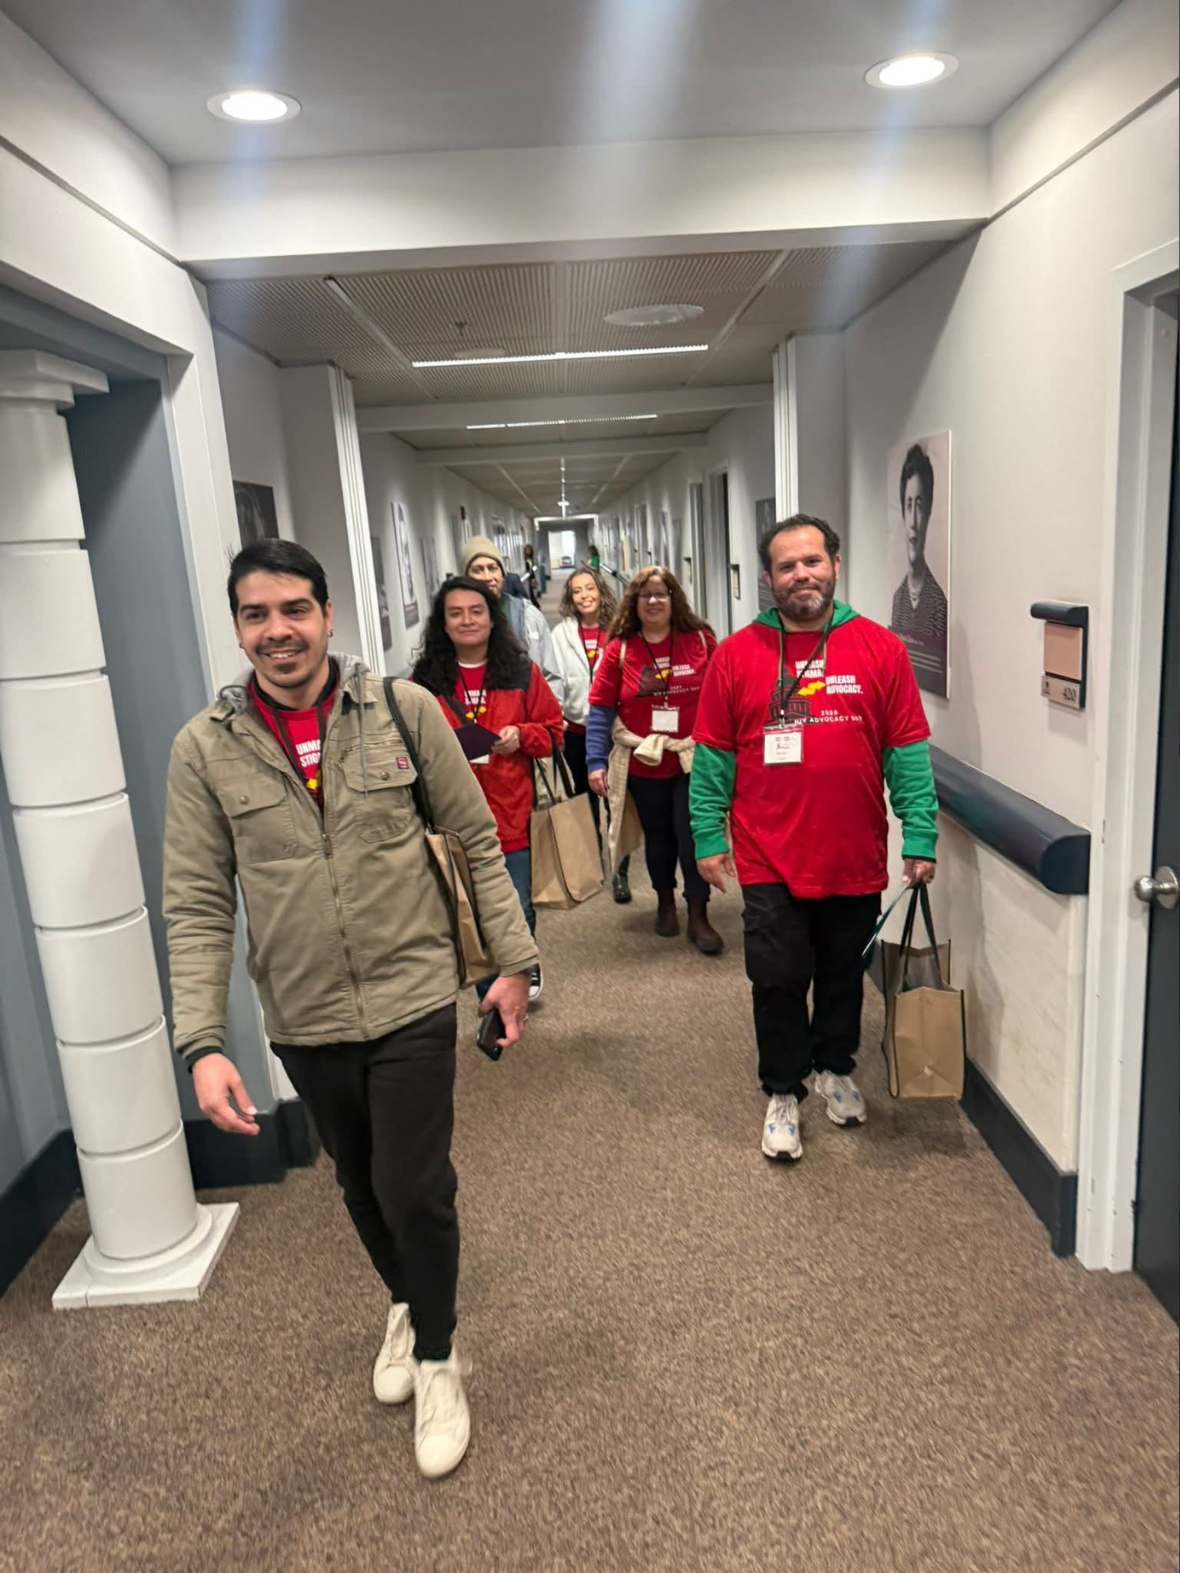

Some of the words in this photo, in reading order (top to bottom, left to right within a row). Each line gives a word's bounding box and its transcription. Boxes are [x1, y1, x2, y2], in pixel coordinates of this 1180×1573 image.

[825, 674, 856, 686] UNLEASH
[826, 684, 864, 695] ADVOCACY.
[809, 715, 850, 723] ADVOCACY
[300, 752, 321, 768] STIG
